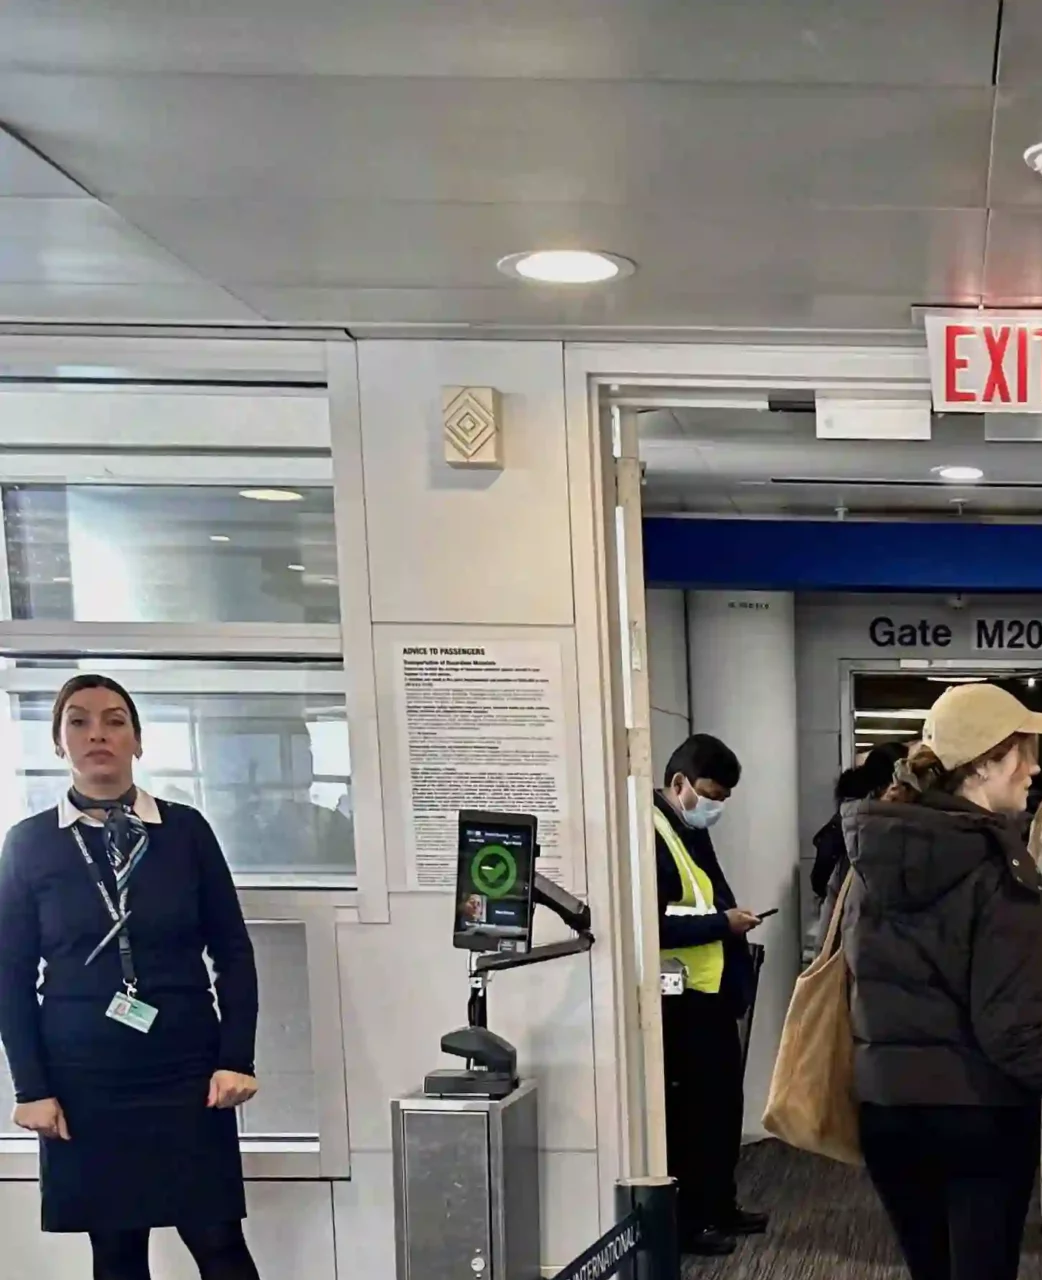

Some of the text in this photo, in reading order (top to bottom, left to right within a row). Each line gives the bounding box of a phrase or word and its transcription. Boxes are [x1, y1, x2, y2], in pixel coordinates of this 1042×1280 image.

[869, 616, 952, 648] Gate
[402, 647, 486, 656] ADVICE TO PASSENGERS
